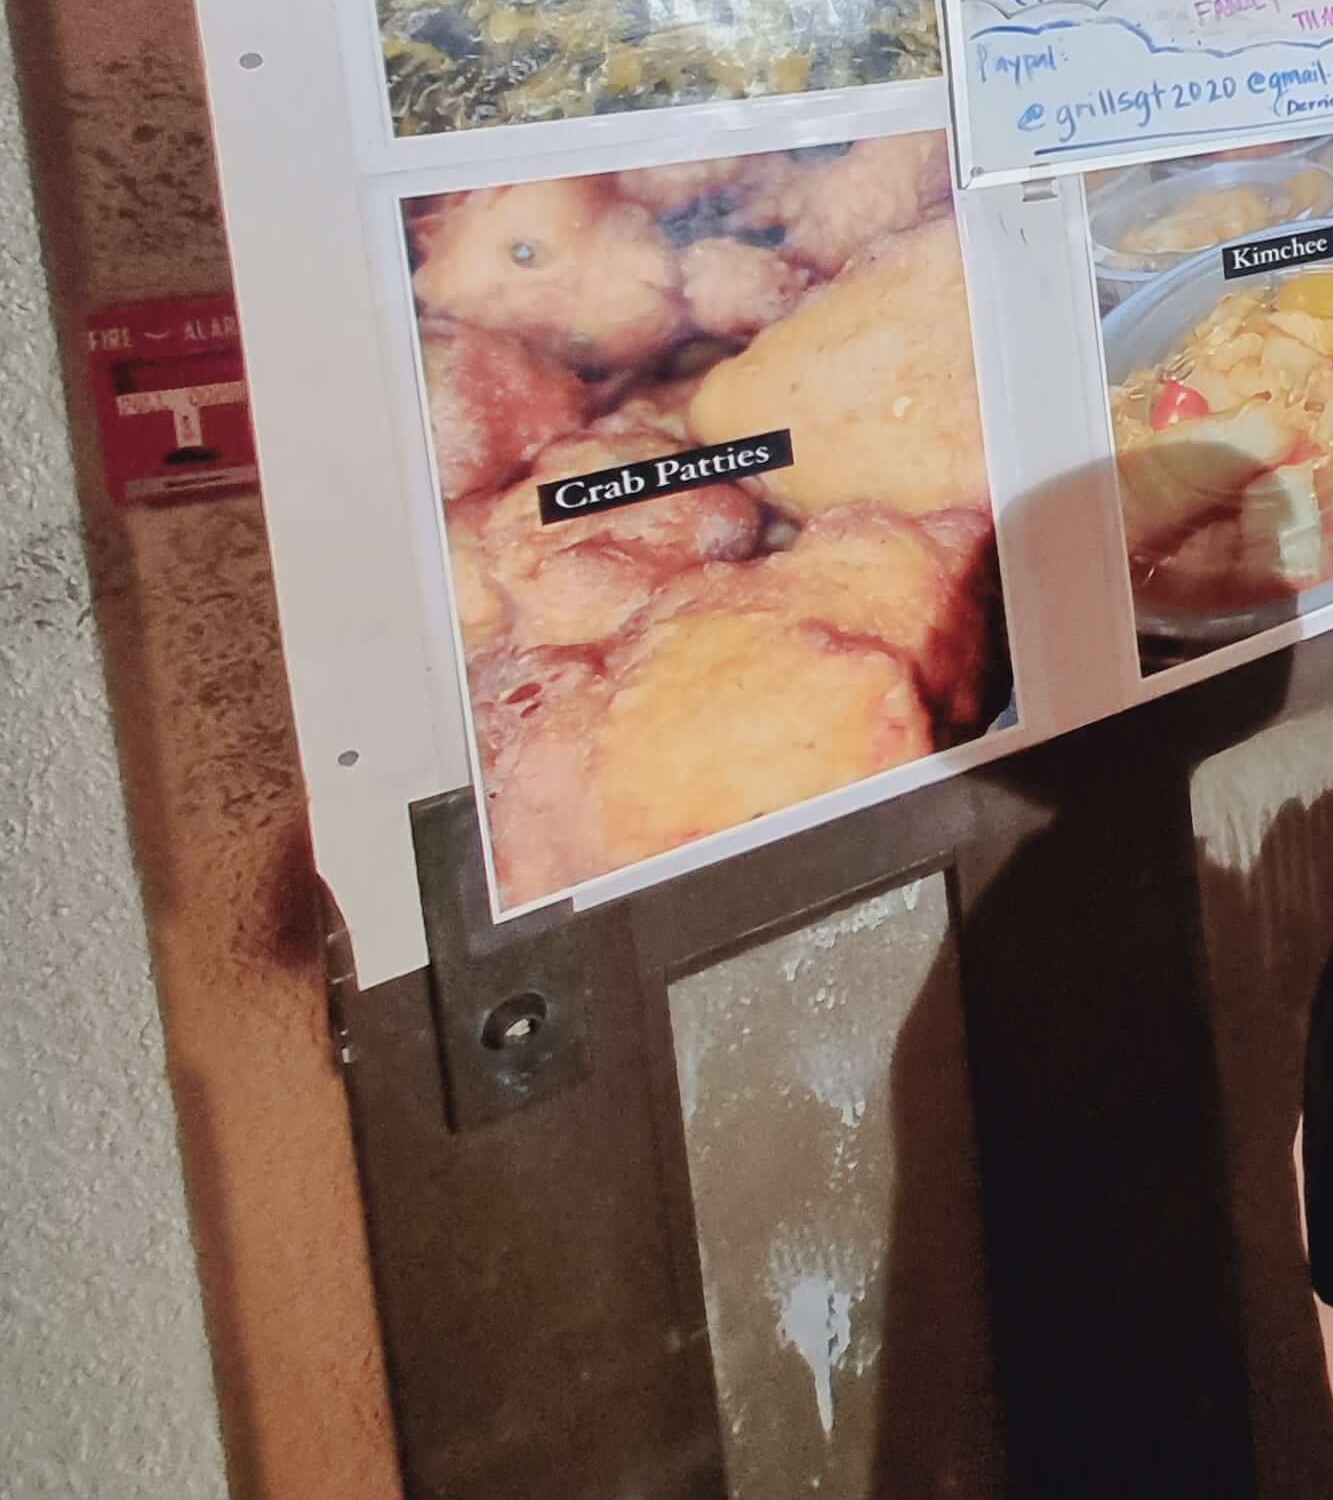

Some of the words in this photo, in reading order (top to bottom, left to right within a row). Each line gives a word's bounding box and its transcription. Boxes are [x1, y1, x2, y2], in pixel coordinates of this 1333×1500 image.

[1232, 237, 1328, 269] Kimchee
[88, 327, 134, 350] FIRE
[555, 470, 645, 509] Crab
[655, 445, 770, 487] Patties
